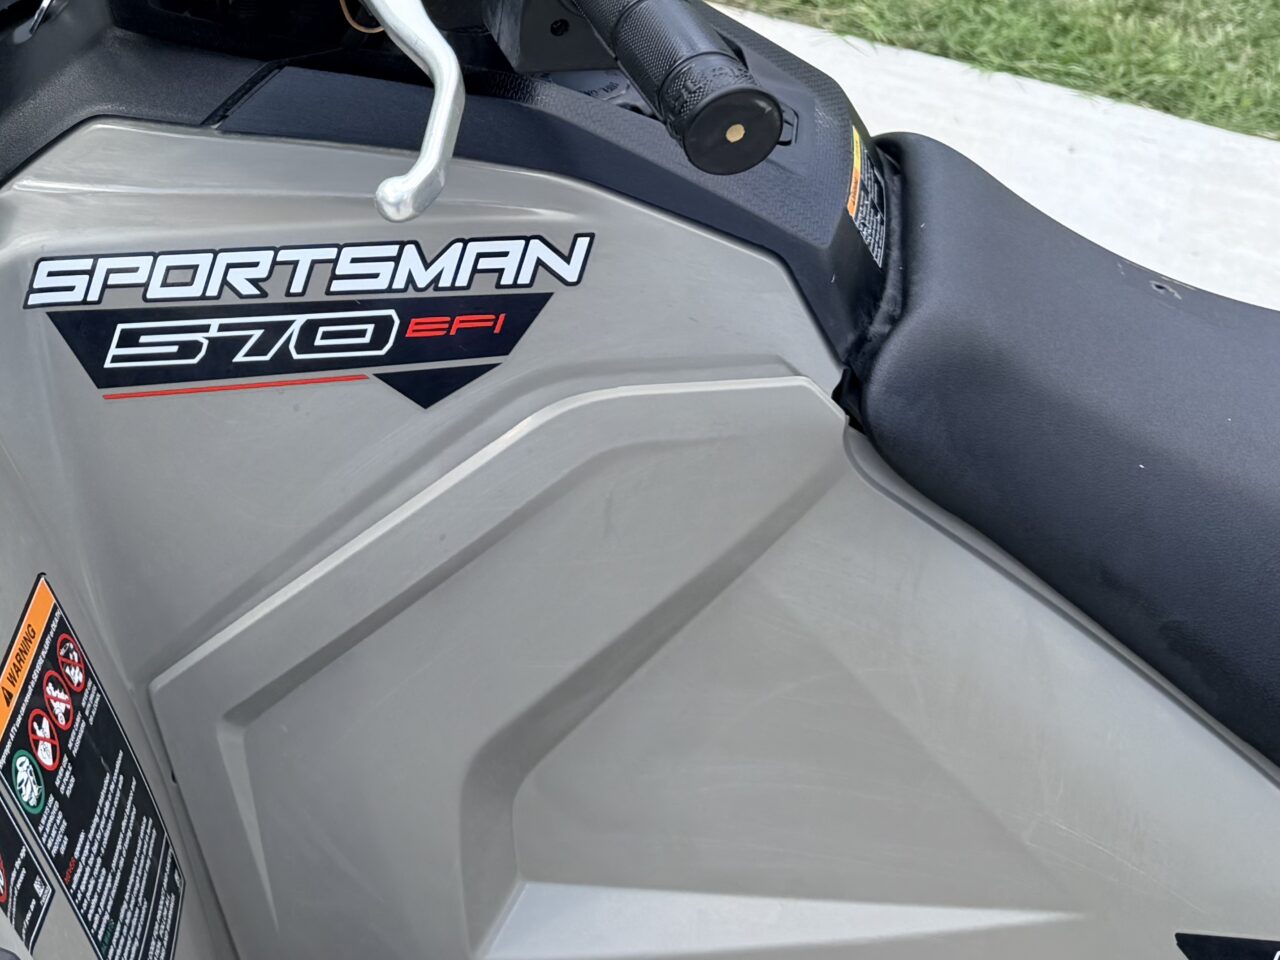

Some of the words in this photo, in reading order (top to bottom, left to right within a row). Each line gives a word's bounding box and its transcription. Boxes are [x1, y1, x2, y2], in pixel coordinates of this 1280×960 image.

[23, 232, 595, 309] SPORTSMAN
[103, 308, 401, 369] 570
[404, 312, 506, 338] EFI
[6, 623, 36, 687] WARNING
[8, 723, 17, 741] ATV
[31, 654, 44, 682] SEVERE
